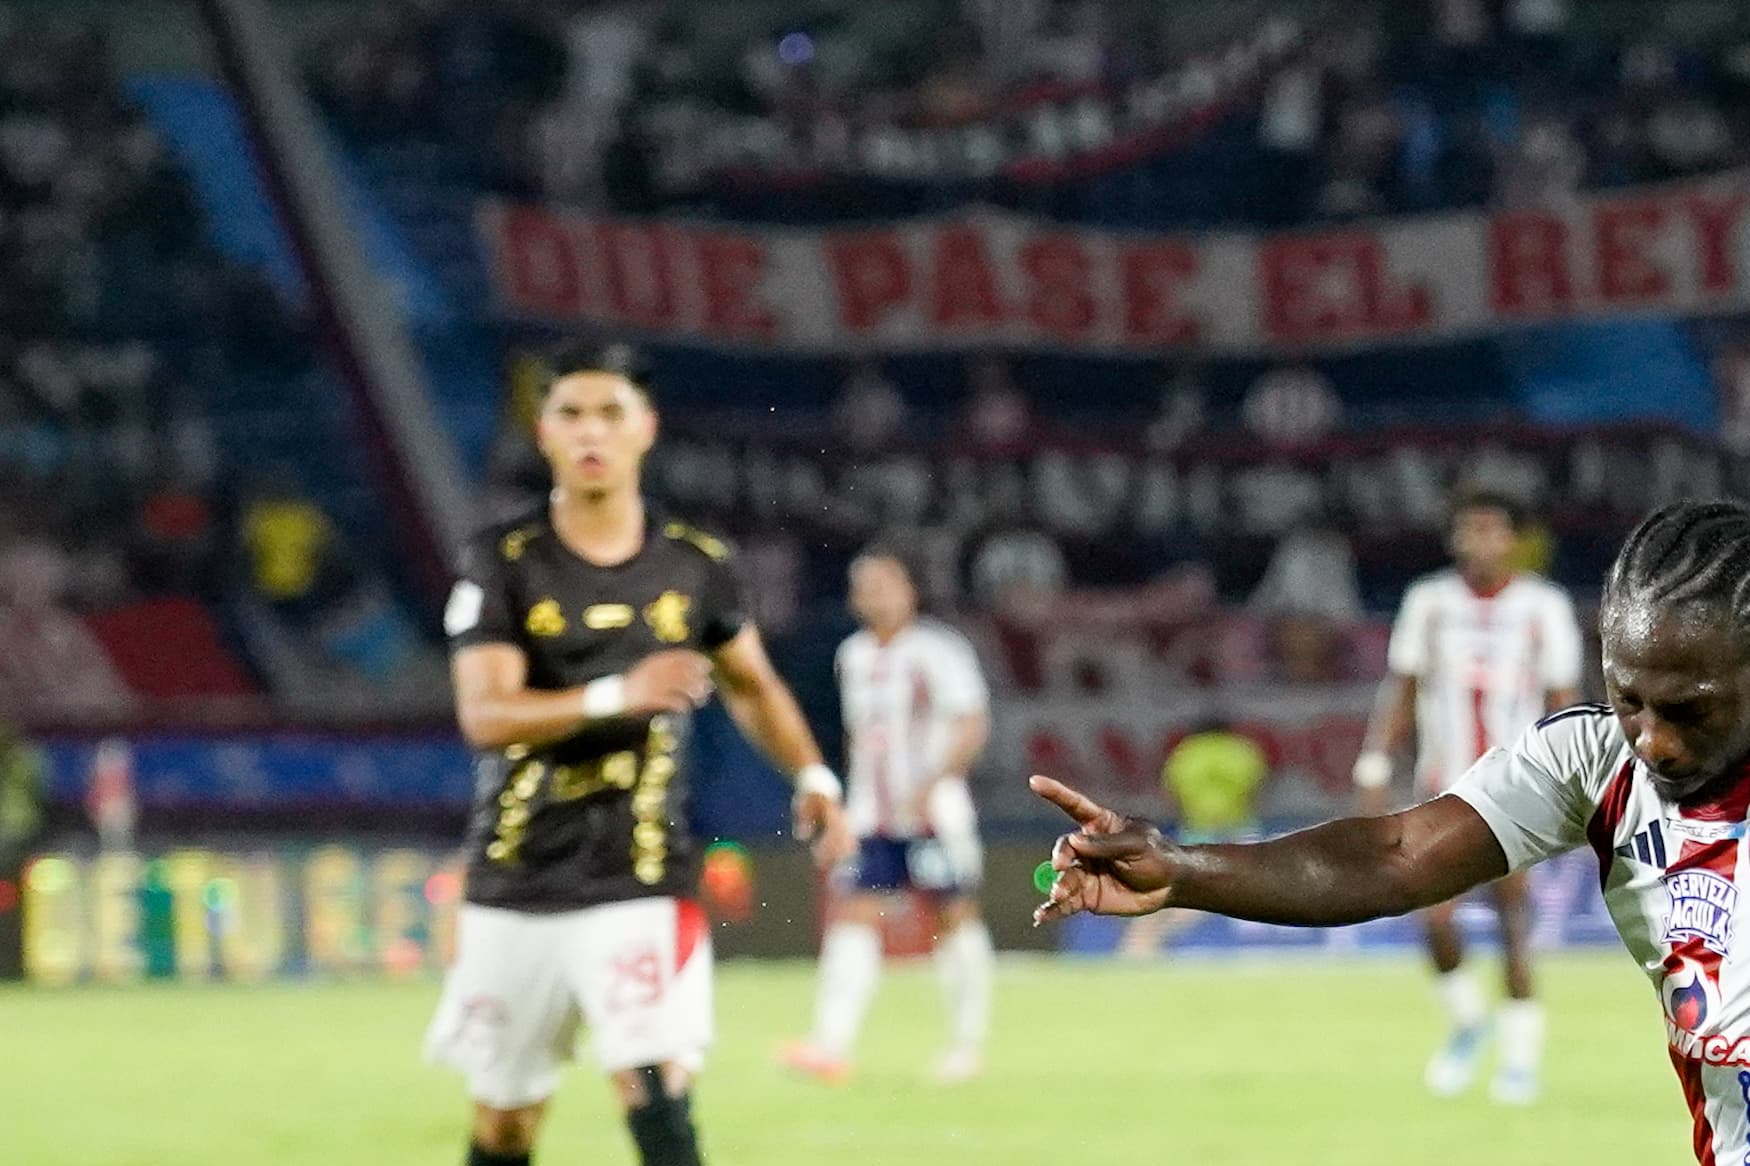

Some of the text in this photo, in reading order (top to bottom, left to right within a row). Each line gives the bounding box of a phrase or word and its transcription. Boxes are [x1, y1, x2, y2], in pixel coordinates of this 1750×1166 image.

[499, 206, 778, 342] QUE
[826, 221, 1204, 347] PASE
[1256, 232, 1434, 340] EL
[1670, 899, 1729, 942] AGUILA
